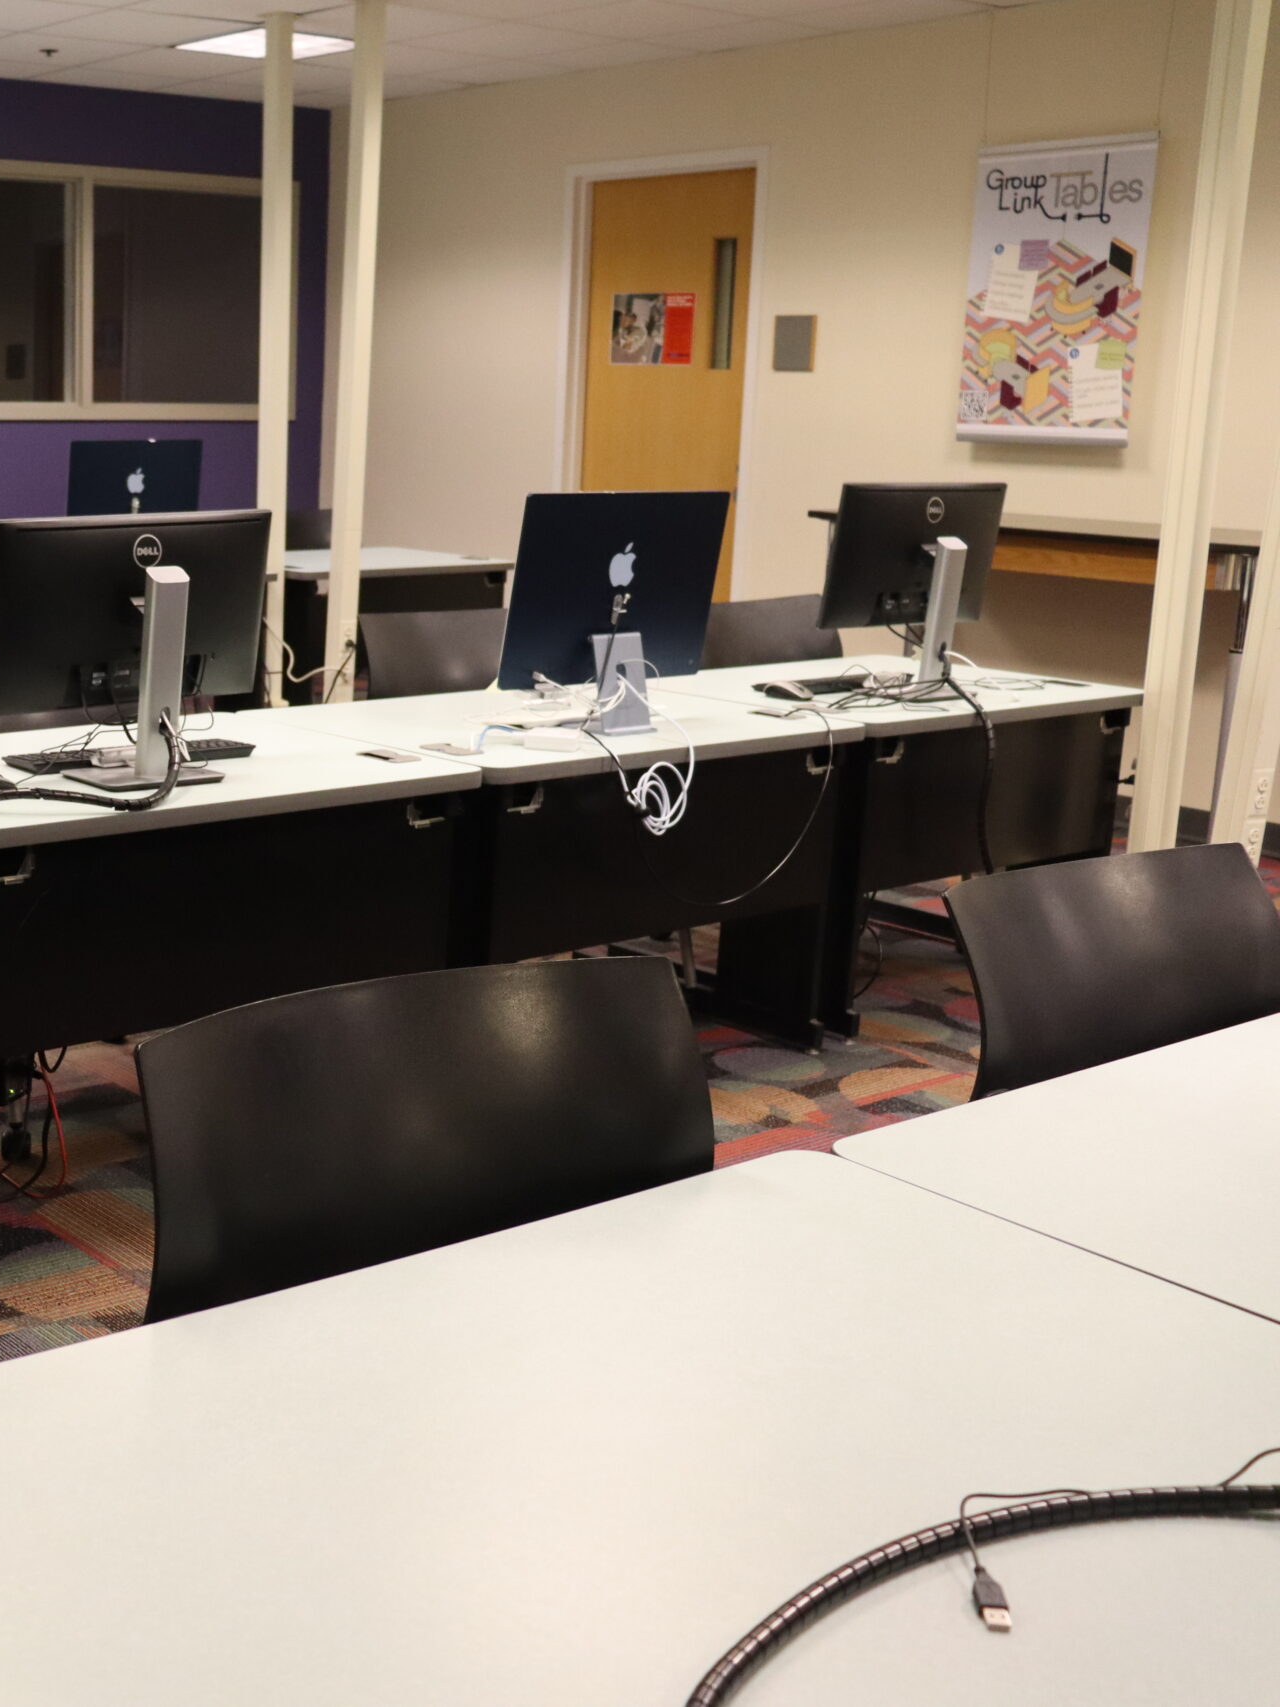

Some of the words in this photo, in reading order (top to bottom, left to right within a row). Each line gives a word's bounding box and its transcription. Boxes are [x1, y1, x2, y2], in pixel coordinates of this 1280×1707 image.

[986, 169, 1047, 190] Group
[1050, 153, 1144, 219] Tables
[999, 187, 1045, 214] Link
[136, 546, 159, 556] DELL
